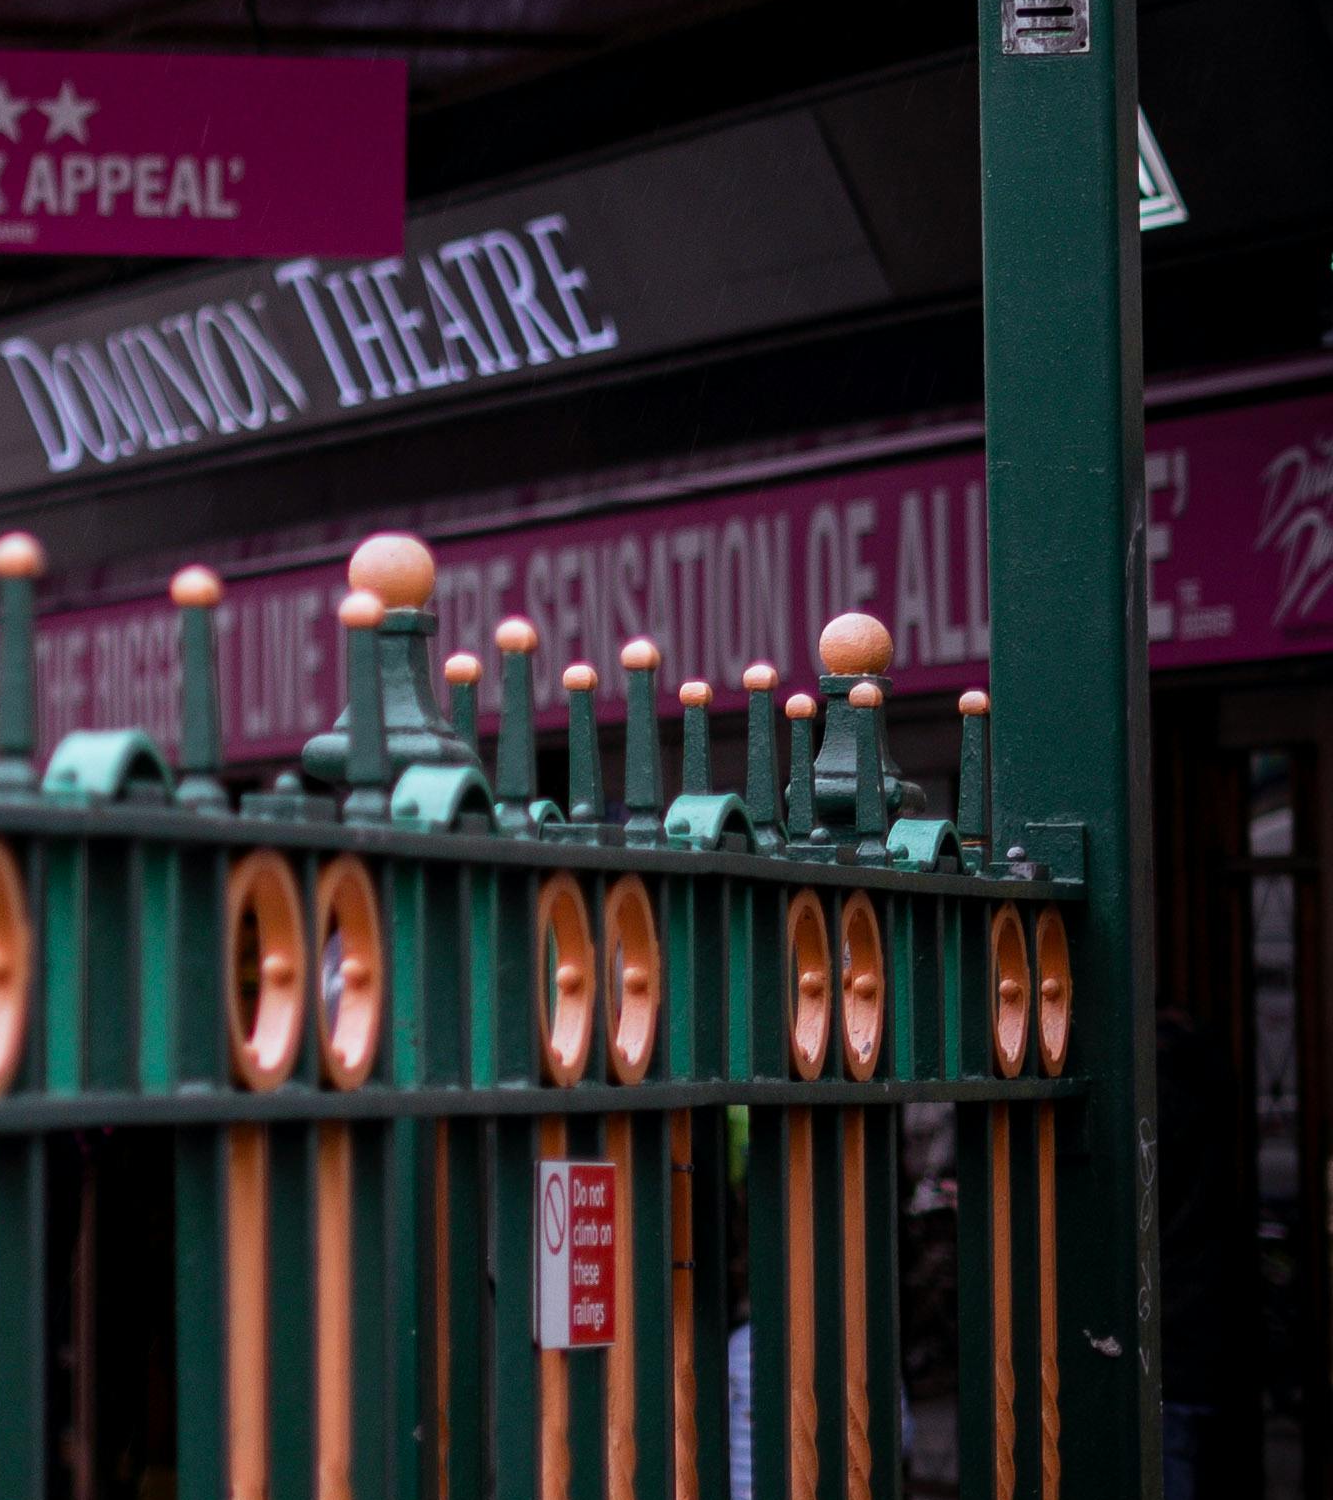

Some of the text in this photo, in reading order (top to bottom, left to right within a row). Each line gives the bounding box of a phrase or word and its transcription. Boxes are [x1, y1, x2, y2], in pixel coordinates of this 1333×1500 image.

[275, 213, 620, 407] THEATRE
[806, 497, 879, 678] OF
[573, 1178, 606, 1208] Do not
[573, 1218, 612, 1247] climb on
[573, 1259, 600, 1286] these
[573, 1296, 606, 1332] railings
